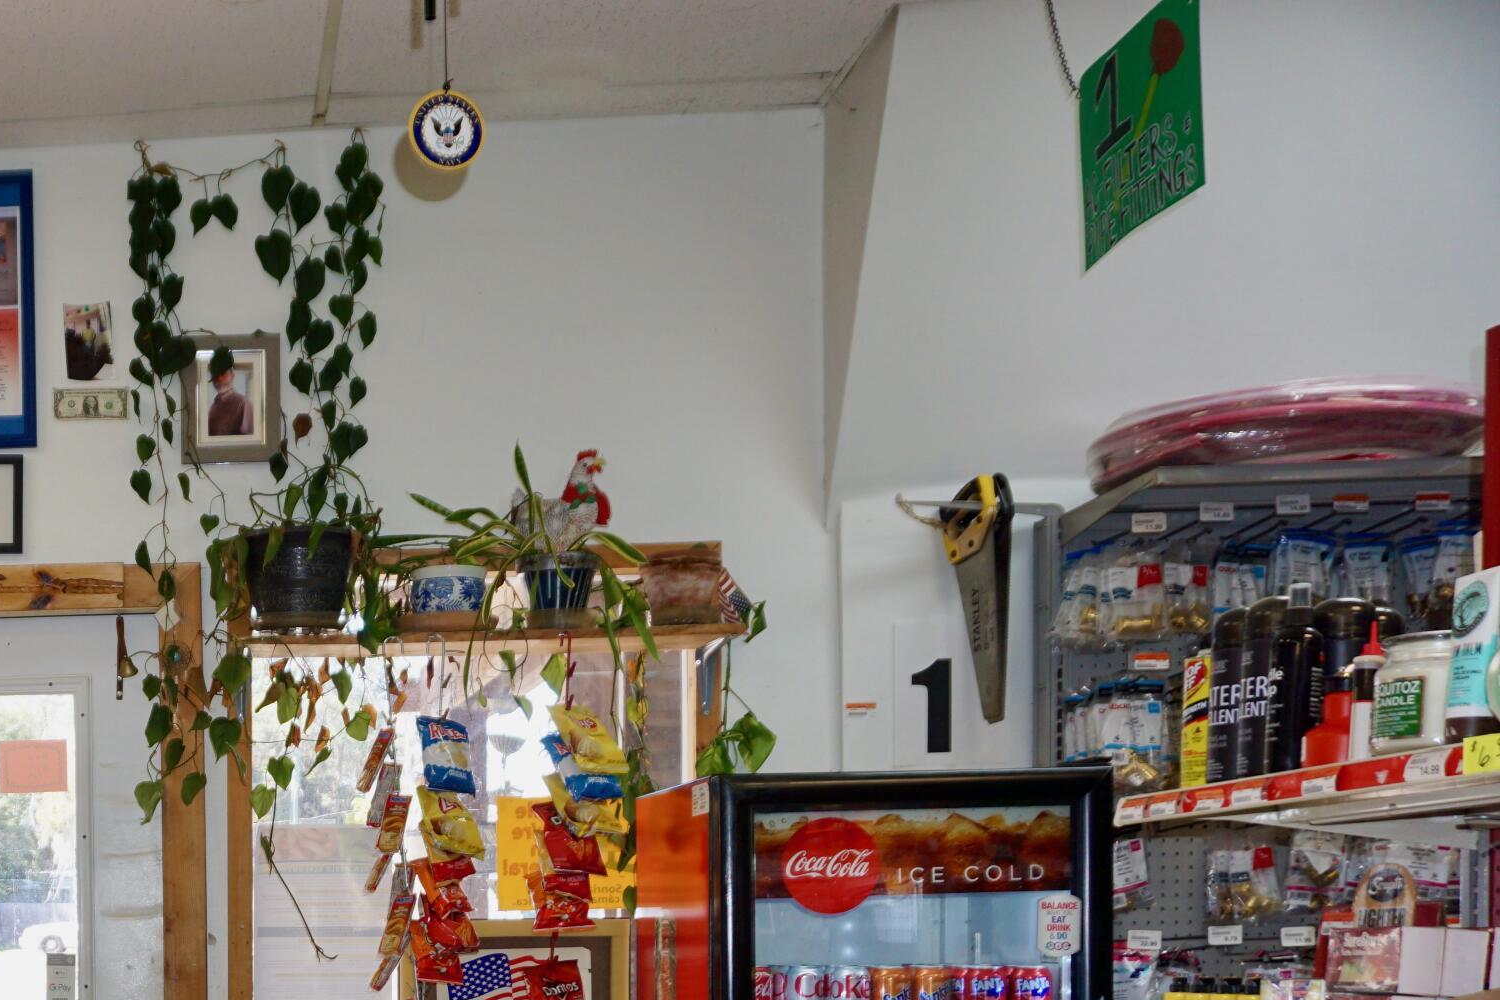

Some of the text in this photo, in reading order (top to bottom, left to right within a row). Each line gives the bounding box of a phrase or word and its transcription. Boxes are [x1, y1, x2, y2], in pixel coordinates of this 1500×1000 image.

[1096, 51, 1131, 160] 1
[973, 588, 981, 652] STANLEY
[911, 657, 952, 753] 1
[785, 848, 874, 879] Coca-Cola
[897, 863, 1046, 884] ICE COLD
[1046, 924, 1071, 932] DRINK
[1051, 915, 1067, 923] EAT
